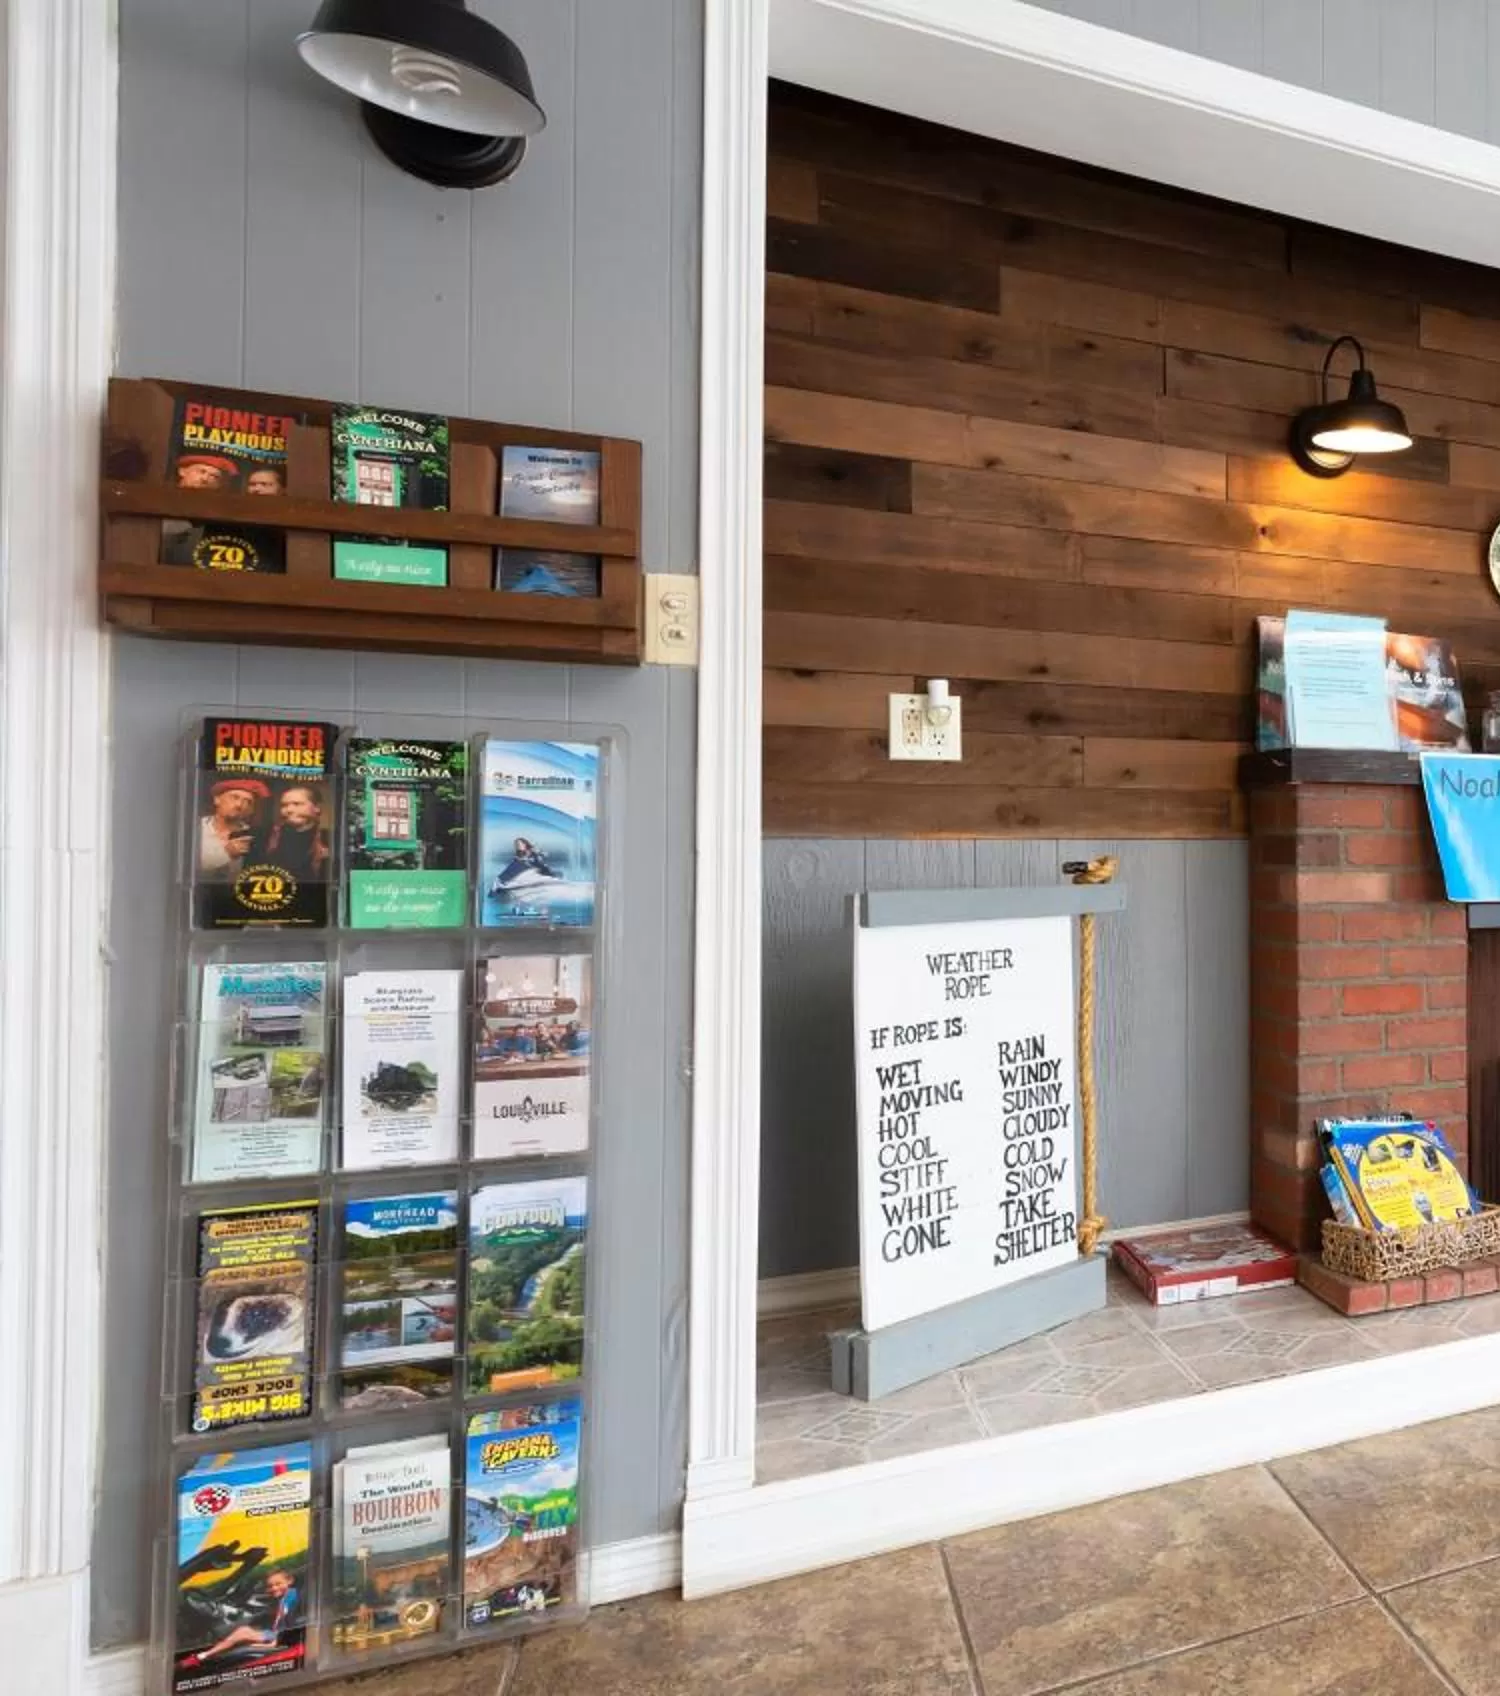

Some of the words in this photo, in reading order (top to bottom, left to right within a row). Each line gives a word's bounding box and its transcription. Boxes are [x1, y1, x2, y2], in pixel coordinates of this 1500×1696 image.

[184, 423, 288, 450] PLAYHOUS
[349, 413, 426, 434] WELCOME
[337, 433, 436, 453] CYNTHIANA
[210, 545, 245, 562] 70
[216, 722, 324, 749] PIONEER
[216, 746, 325, 766] PLAYHOUSE
[368, 744, 443, 761] WELCOME
[356, 765, 452, 778] CYNTHIANA
[250, 876, 283, 893] 70
[926, 948, 1014, 975] WEATHER
[945, 974, 991, 1001] ROPE
[869, 1027, 890, 1050] IF
[893, 1021, 939, 1047] ROPE
[997, 1034, 1045, 1067] RAIN
[876, 1059, 922, 1091] WET
[999, 1058, 1062, 1090] WINDY
[880, 1080, 963, 1118] MOVING
[1002, 1082, 1063, 1115] SUNNY
[878, 1111, 920, 1143] HOT
[1003, 1103, 1071, 1141] CLOUDY
[878, 1136, 938, 1169] COOL
[1003, 1136, 1054, 1169] COLD
[880, 1159, 948, 1198] STIFF
[1005, 1158, 1068, 1198] SNOW
[373, 1207, 435, 1221] MOREHEAD
[881, 1186, 958, 1228] WHITE
[999, 1188, 1056, 1229] TAKE
[881, 1216, 951, 1263] GONE
[994, 1211, 1076, 1266] SHELTER
[211, 1383, 249, 1399] SHOP
[255, 1377, 294, 1393] ROCK
[201, 1399, 267, 1420] MIKE'S
[271, 1392, 303, 1411] BIG
[489, 1445, 559, 1466] CAVERNS
[360, 1487, 385, 1499] The
[352, 1488, 441, 1526] BOURBON
